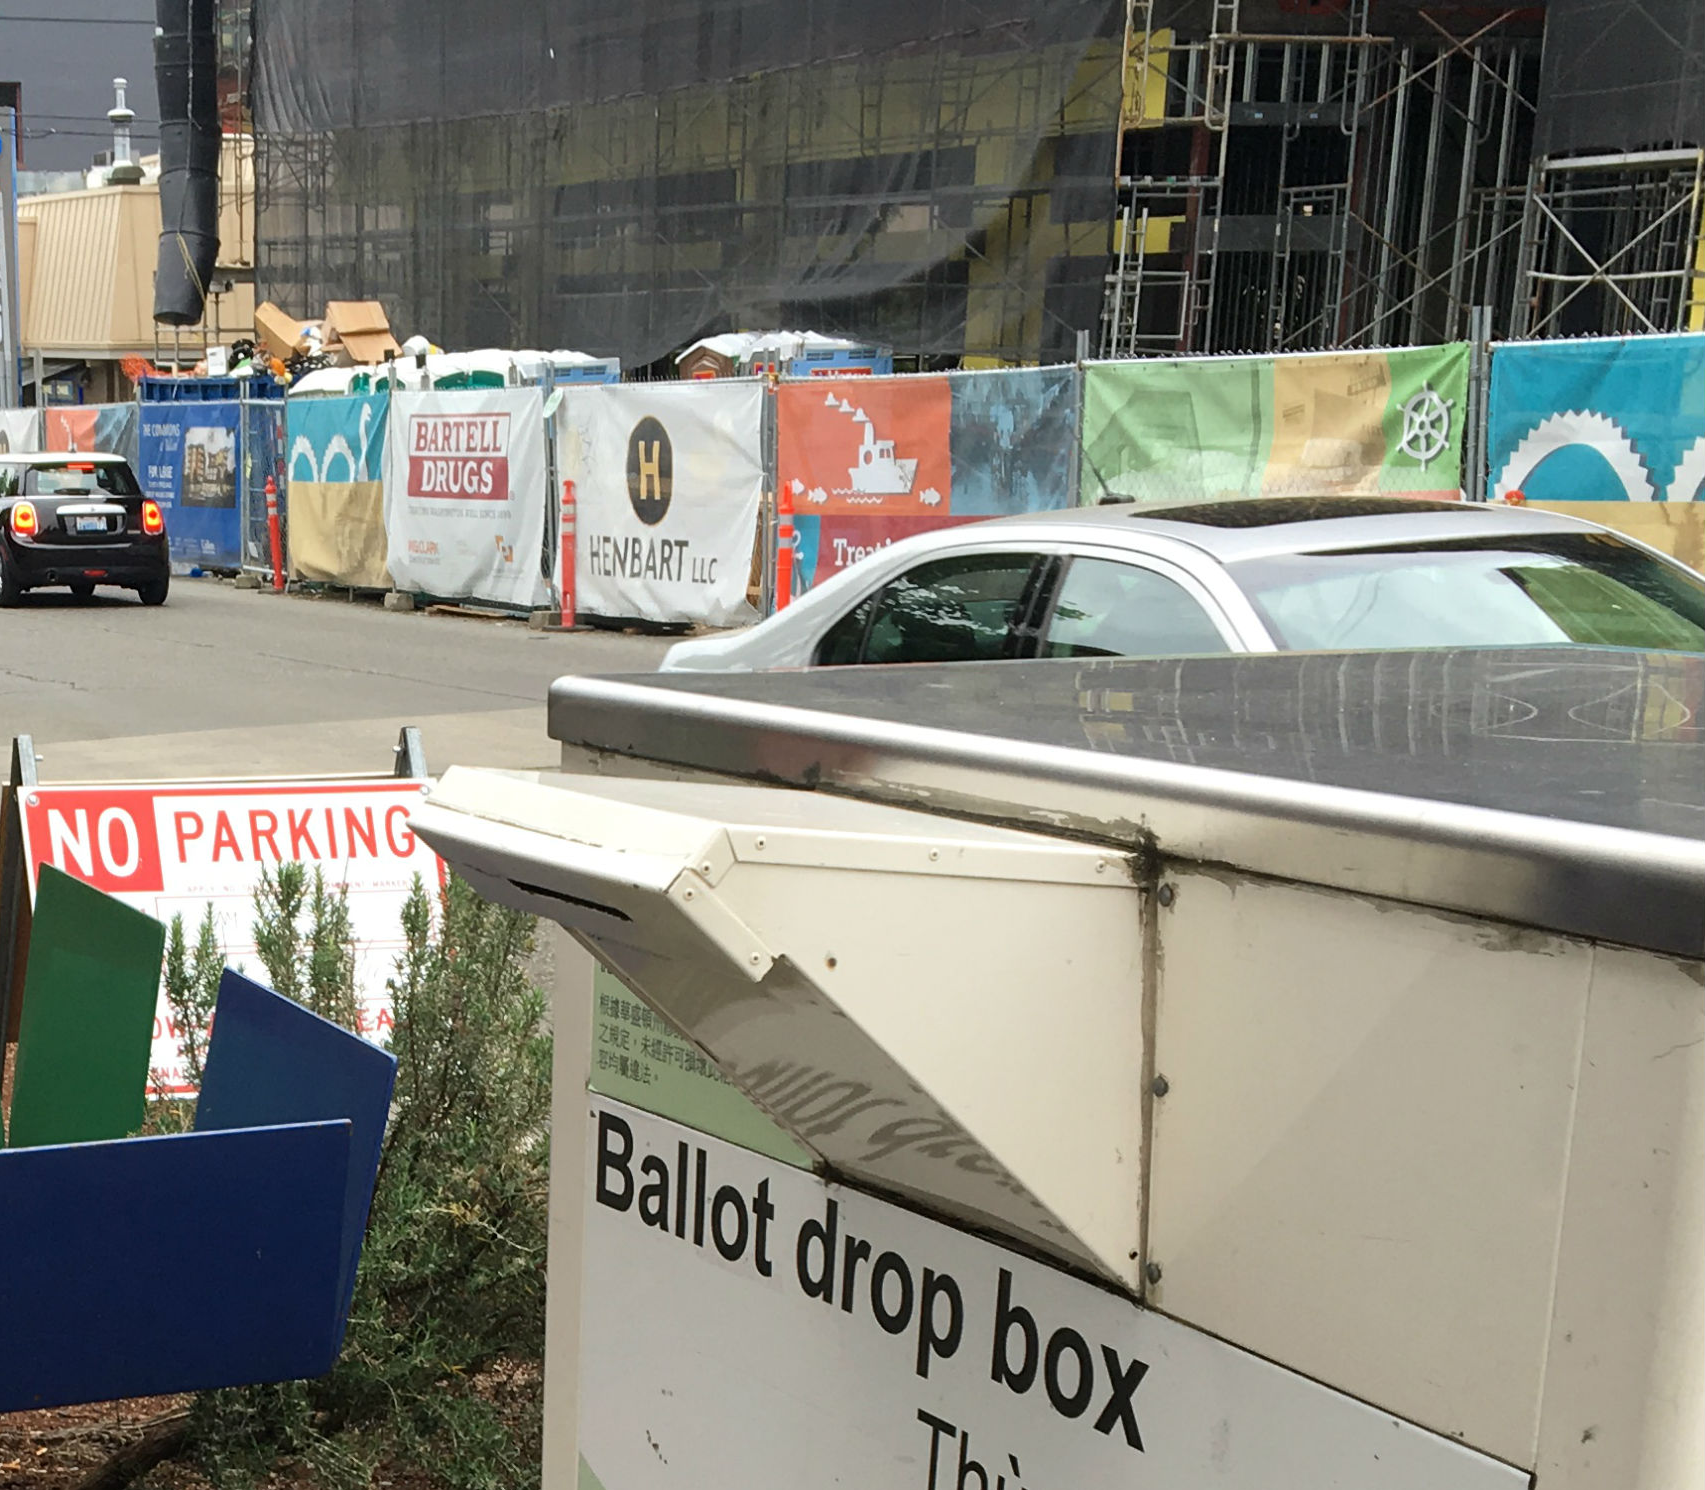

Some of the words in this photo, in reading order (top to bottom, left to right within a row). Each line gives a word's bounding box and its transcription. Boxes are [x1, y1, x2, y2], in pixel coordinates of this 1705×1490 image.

[415, 420, 502, 453] BARTELL
[420, 459, 493, 494] DRUGS
[638, 440, 661, 501] H
[590, 535, 689, 582] HENBART
[691, 556, 718, 585] LLC
[46, 806, 141, 877] NO
[172, 804, 417, 864] PARKING
[595, 1110, 775, 1278] Ballot
[796, 1199, 964, 1377] drop
[993, 1268, 1149, 1452] box
